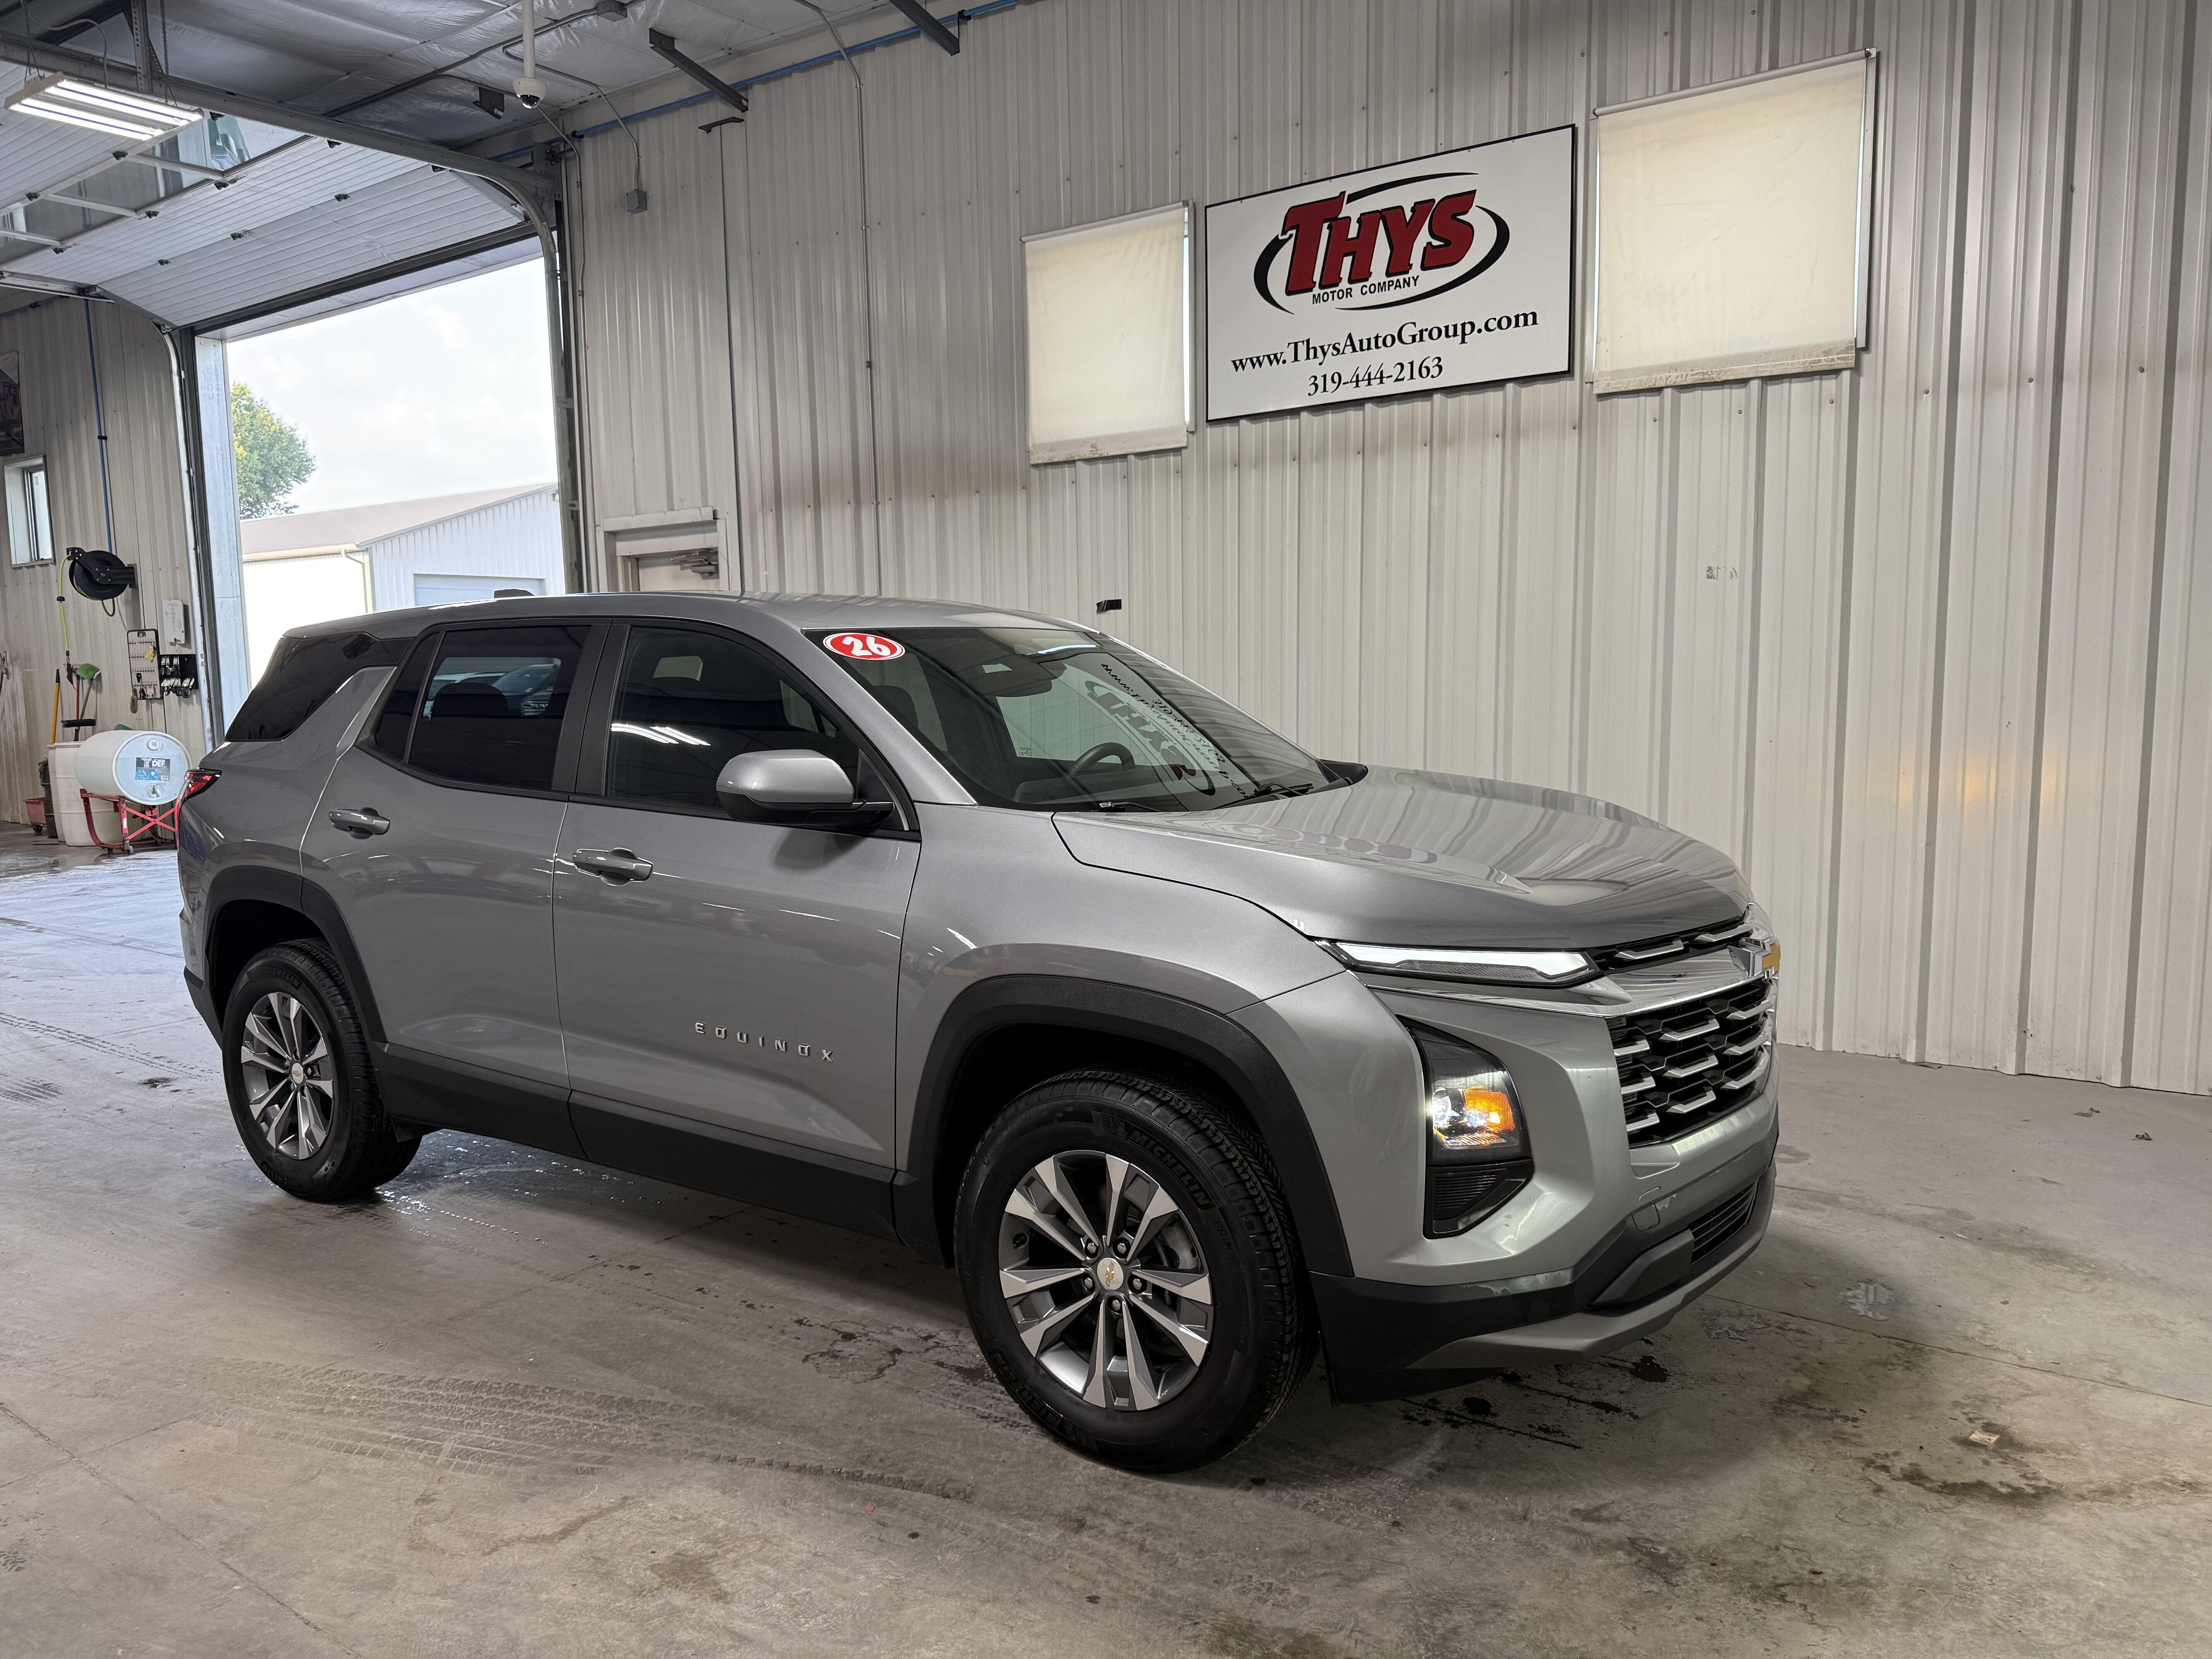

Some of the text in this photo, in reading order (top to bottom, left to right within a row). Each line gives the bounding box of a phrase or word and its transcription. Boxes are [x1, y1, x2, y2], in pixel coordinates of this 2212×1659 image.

[1281, 189, 1477, 296] THYS
[1312, 275, 1420, 305] MOTOR COMPANY
[1231, 310, 1539, 373] www.ThysAutoGroup.com
[1307, 356, 1443, 396] 319-444-2163
[843, 635, 890, 657] 26
[152, 759, 165, 767] DEF
[695, 1022, 834, 1062] EQUINOX
[1130, 1129, 1211, 1208] MICHELIN
